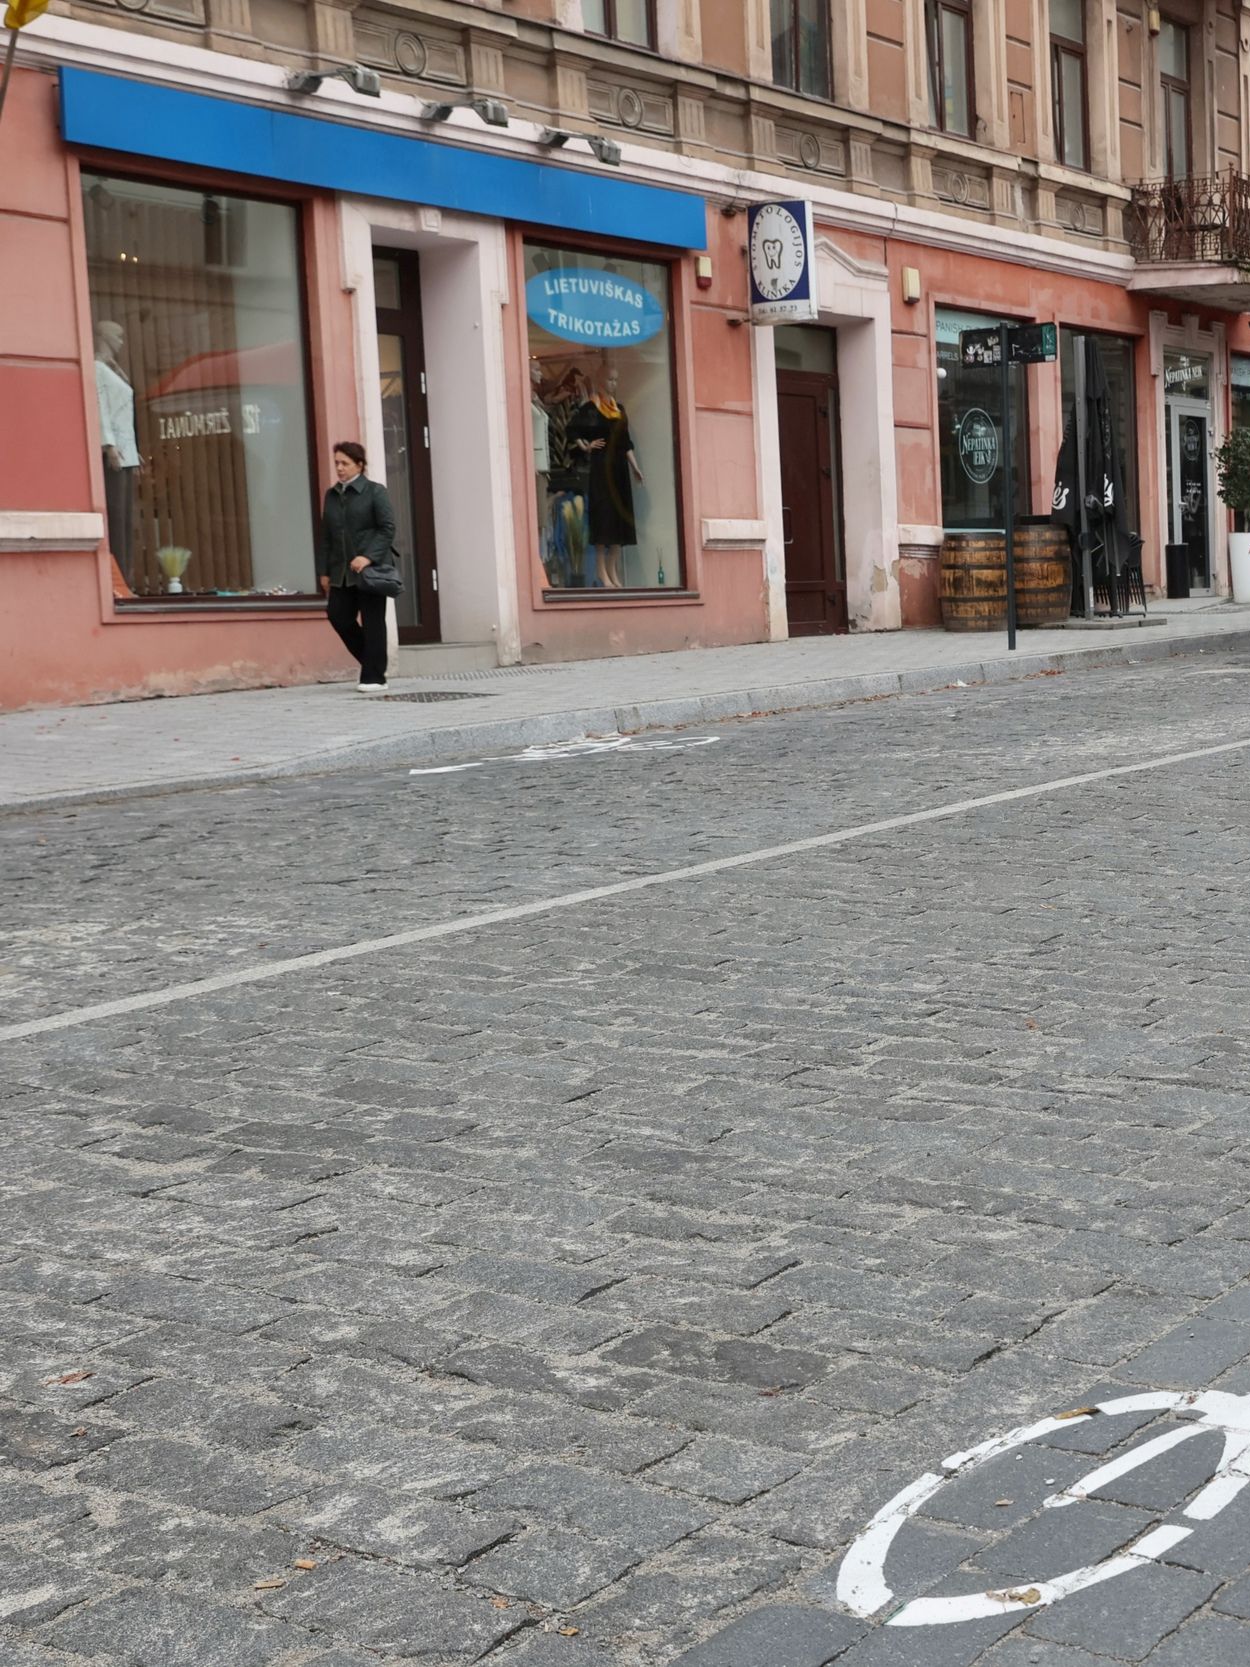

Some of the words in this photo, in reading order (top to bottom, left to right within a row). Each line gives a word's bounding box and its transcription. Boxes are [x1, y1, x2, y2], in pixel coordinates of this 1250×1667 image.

[751, 206, 803, 272] STOMATOLOGIJOS
[544, 278, 644, 309] LIETUVIŠKAS
[757, 279, 796, 299] KLINIKA
[547, 307, 641, 338] TRIKOTAŽAS
[961, 432, 996, 456] NEPATINKA
